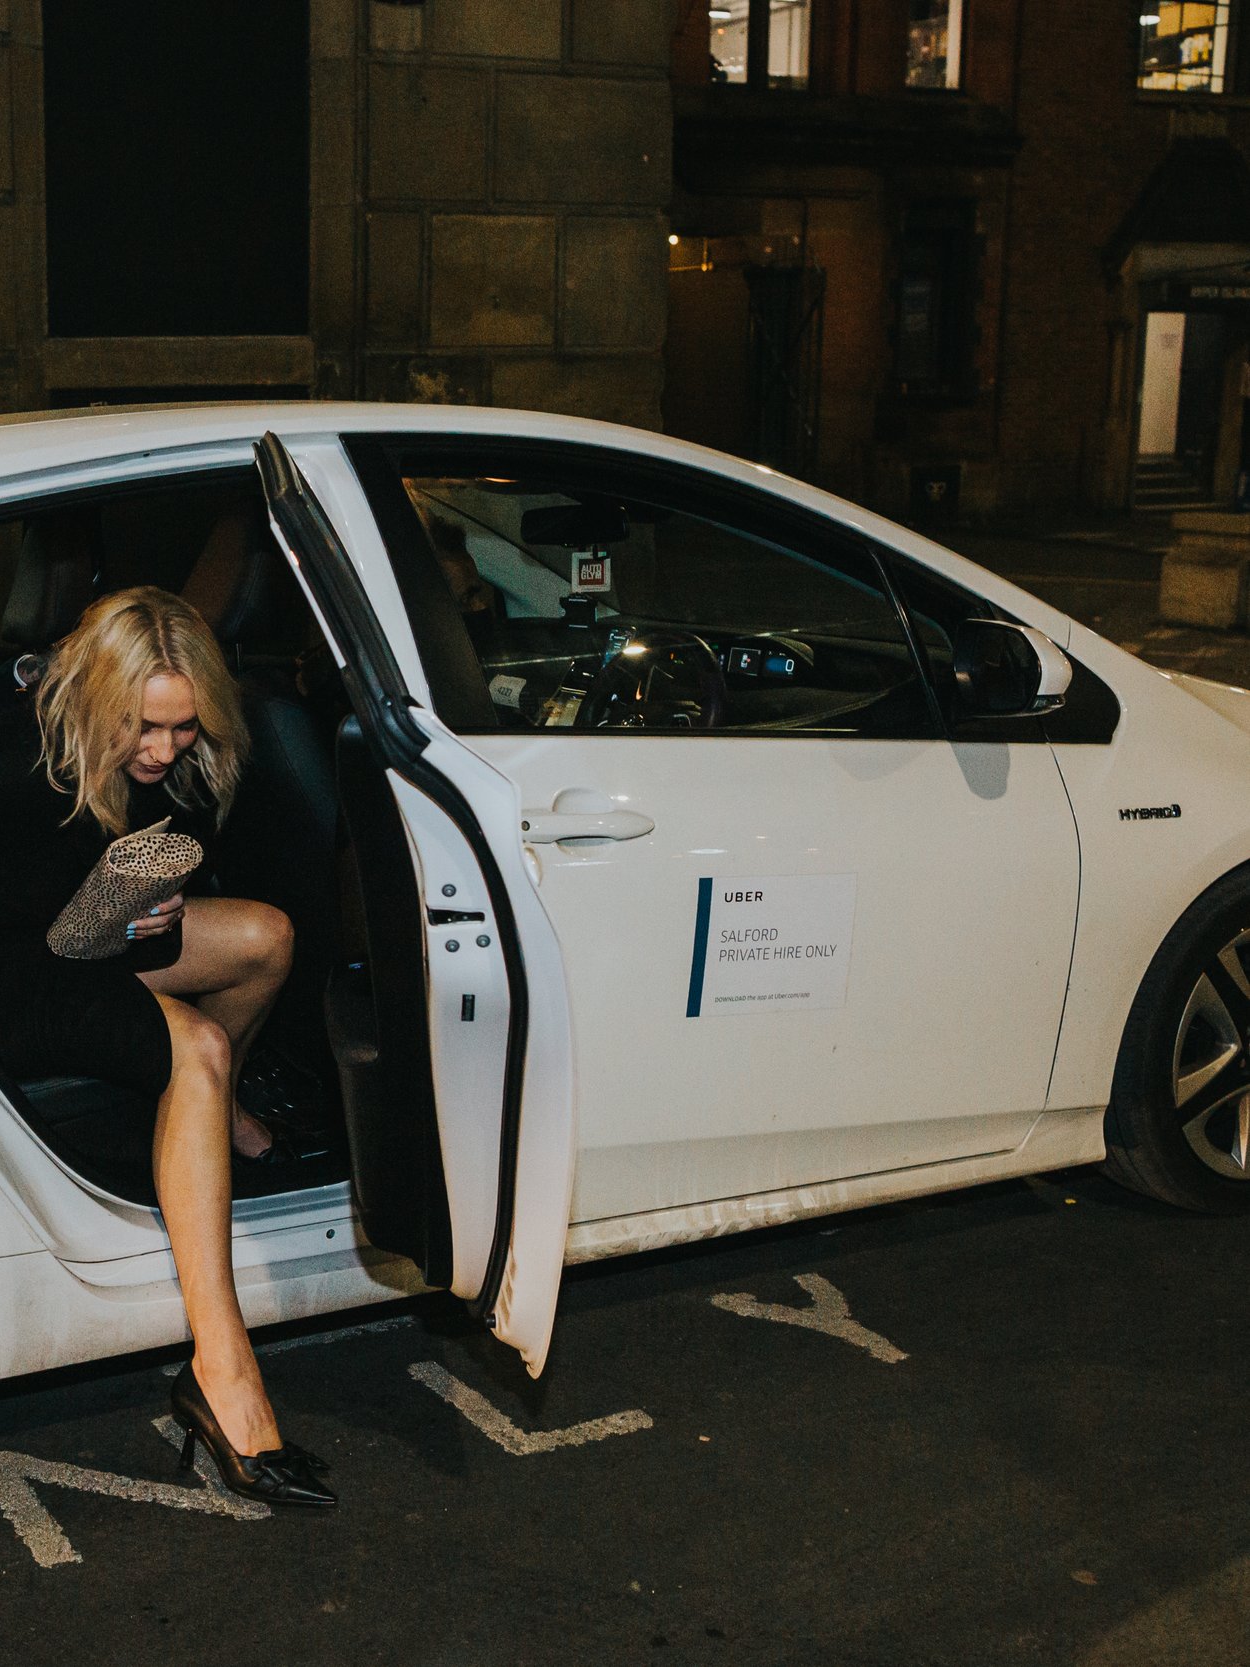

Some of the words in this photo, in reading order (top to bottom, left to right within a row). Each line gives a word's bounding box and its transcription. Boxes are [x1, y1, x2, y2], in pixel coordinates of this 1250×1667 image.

[581, 563, 602, 571] AUTO
[1118, 806, 1172, 821] HYBRID
[724, 891, 764, 903] UBER
[720, 928, 779, 944] SALFORD
[718, 947, 771, 962] PRIVATE
[773, 945, 803, 960] HIRE
[805, 944, 838, 958] ONLY
[714, 995, 747, 1003] DOWNLOAD
